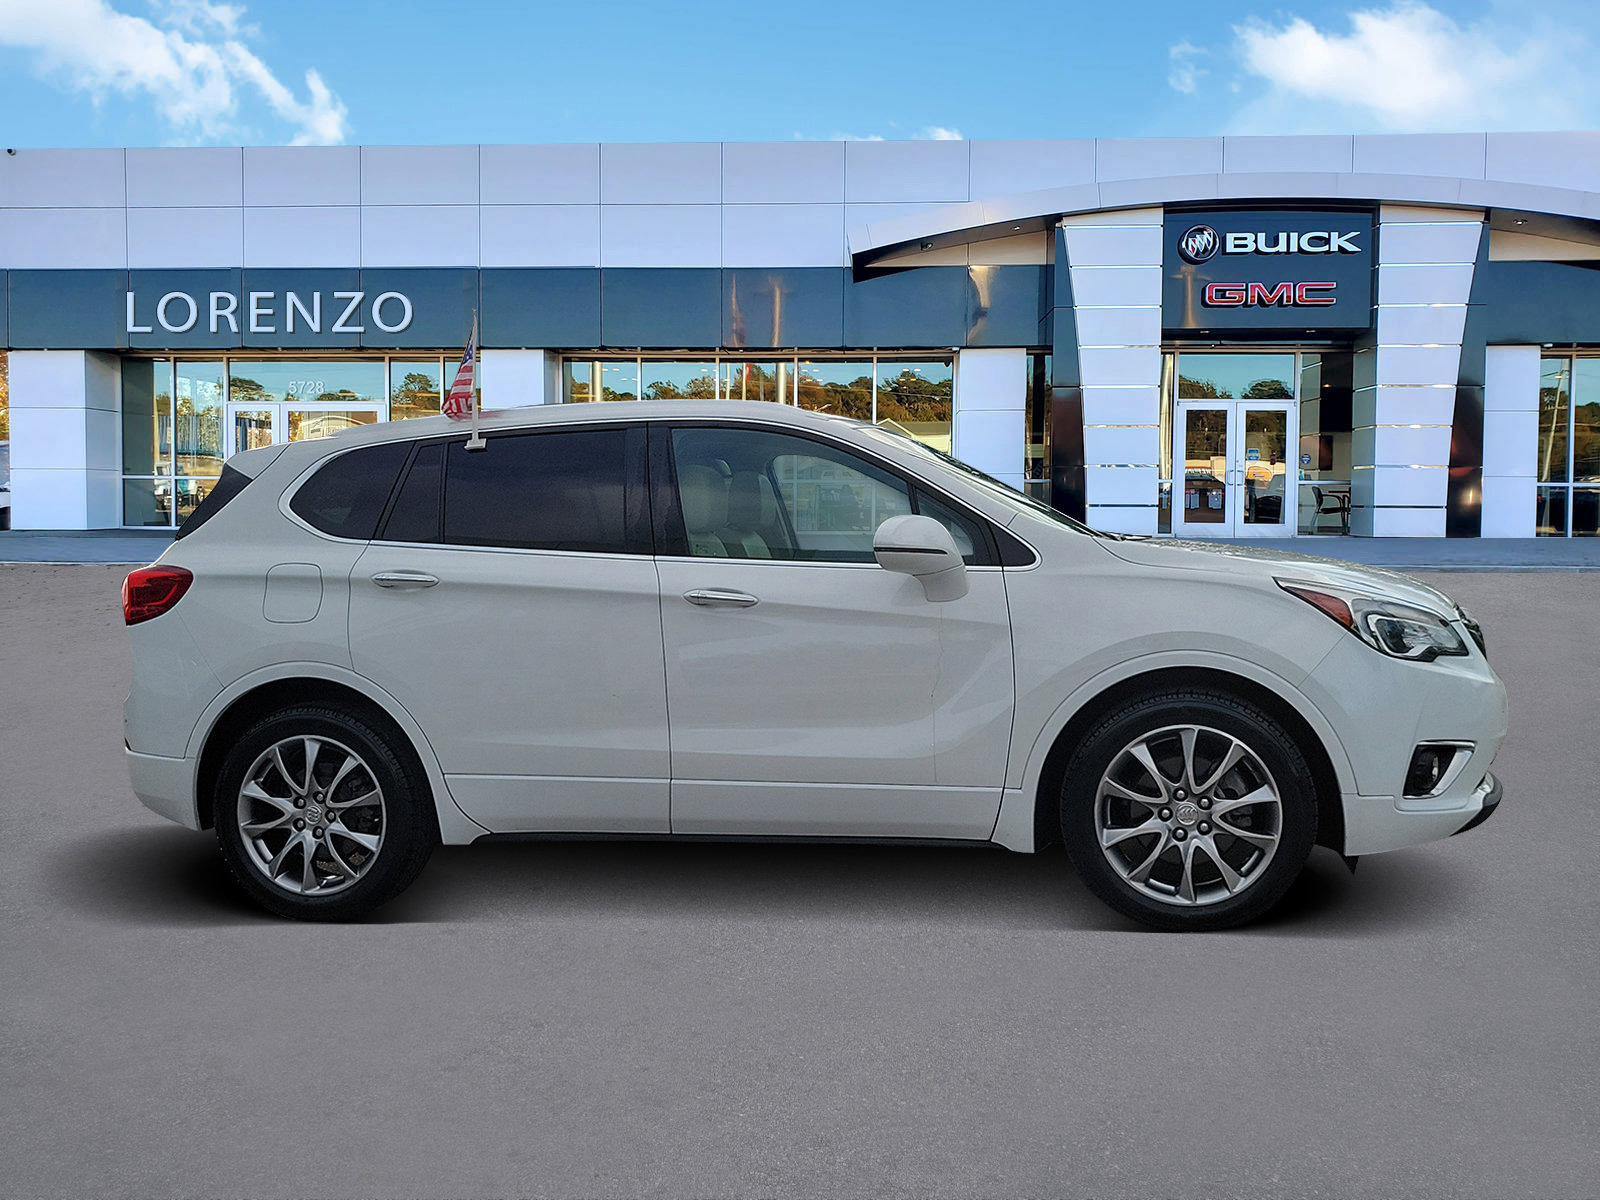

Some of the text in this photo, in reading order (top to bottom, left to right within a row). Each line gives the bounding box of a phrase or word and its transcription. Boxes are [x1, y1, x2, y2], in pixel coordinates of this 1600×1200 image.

[1225, 231, 1362, 253] BUICK
[1205, 281, 1337, 306] GMC
[126, 290, 414, 334] LORENZO
[288, 380, 325, 395] 5728
